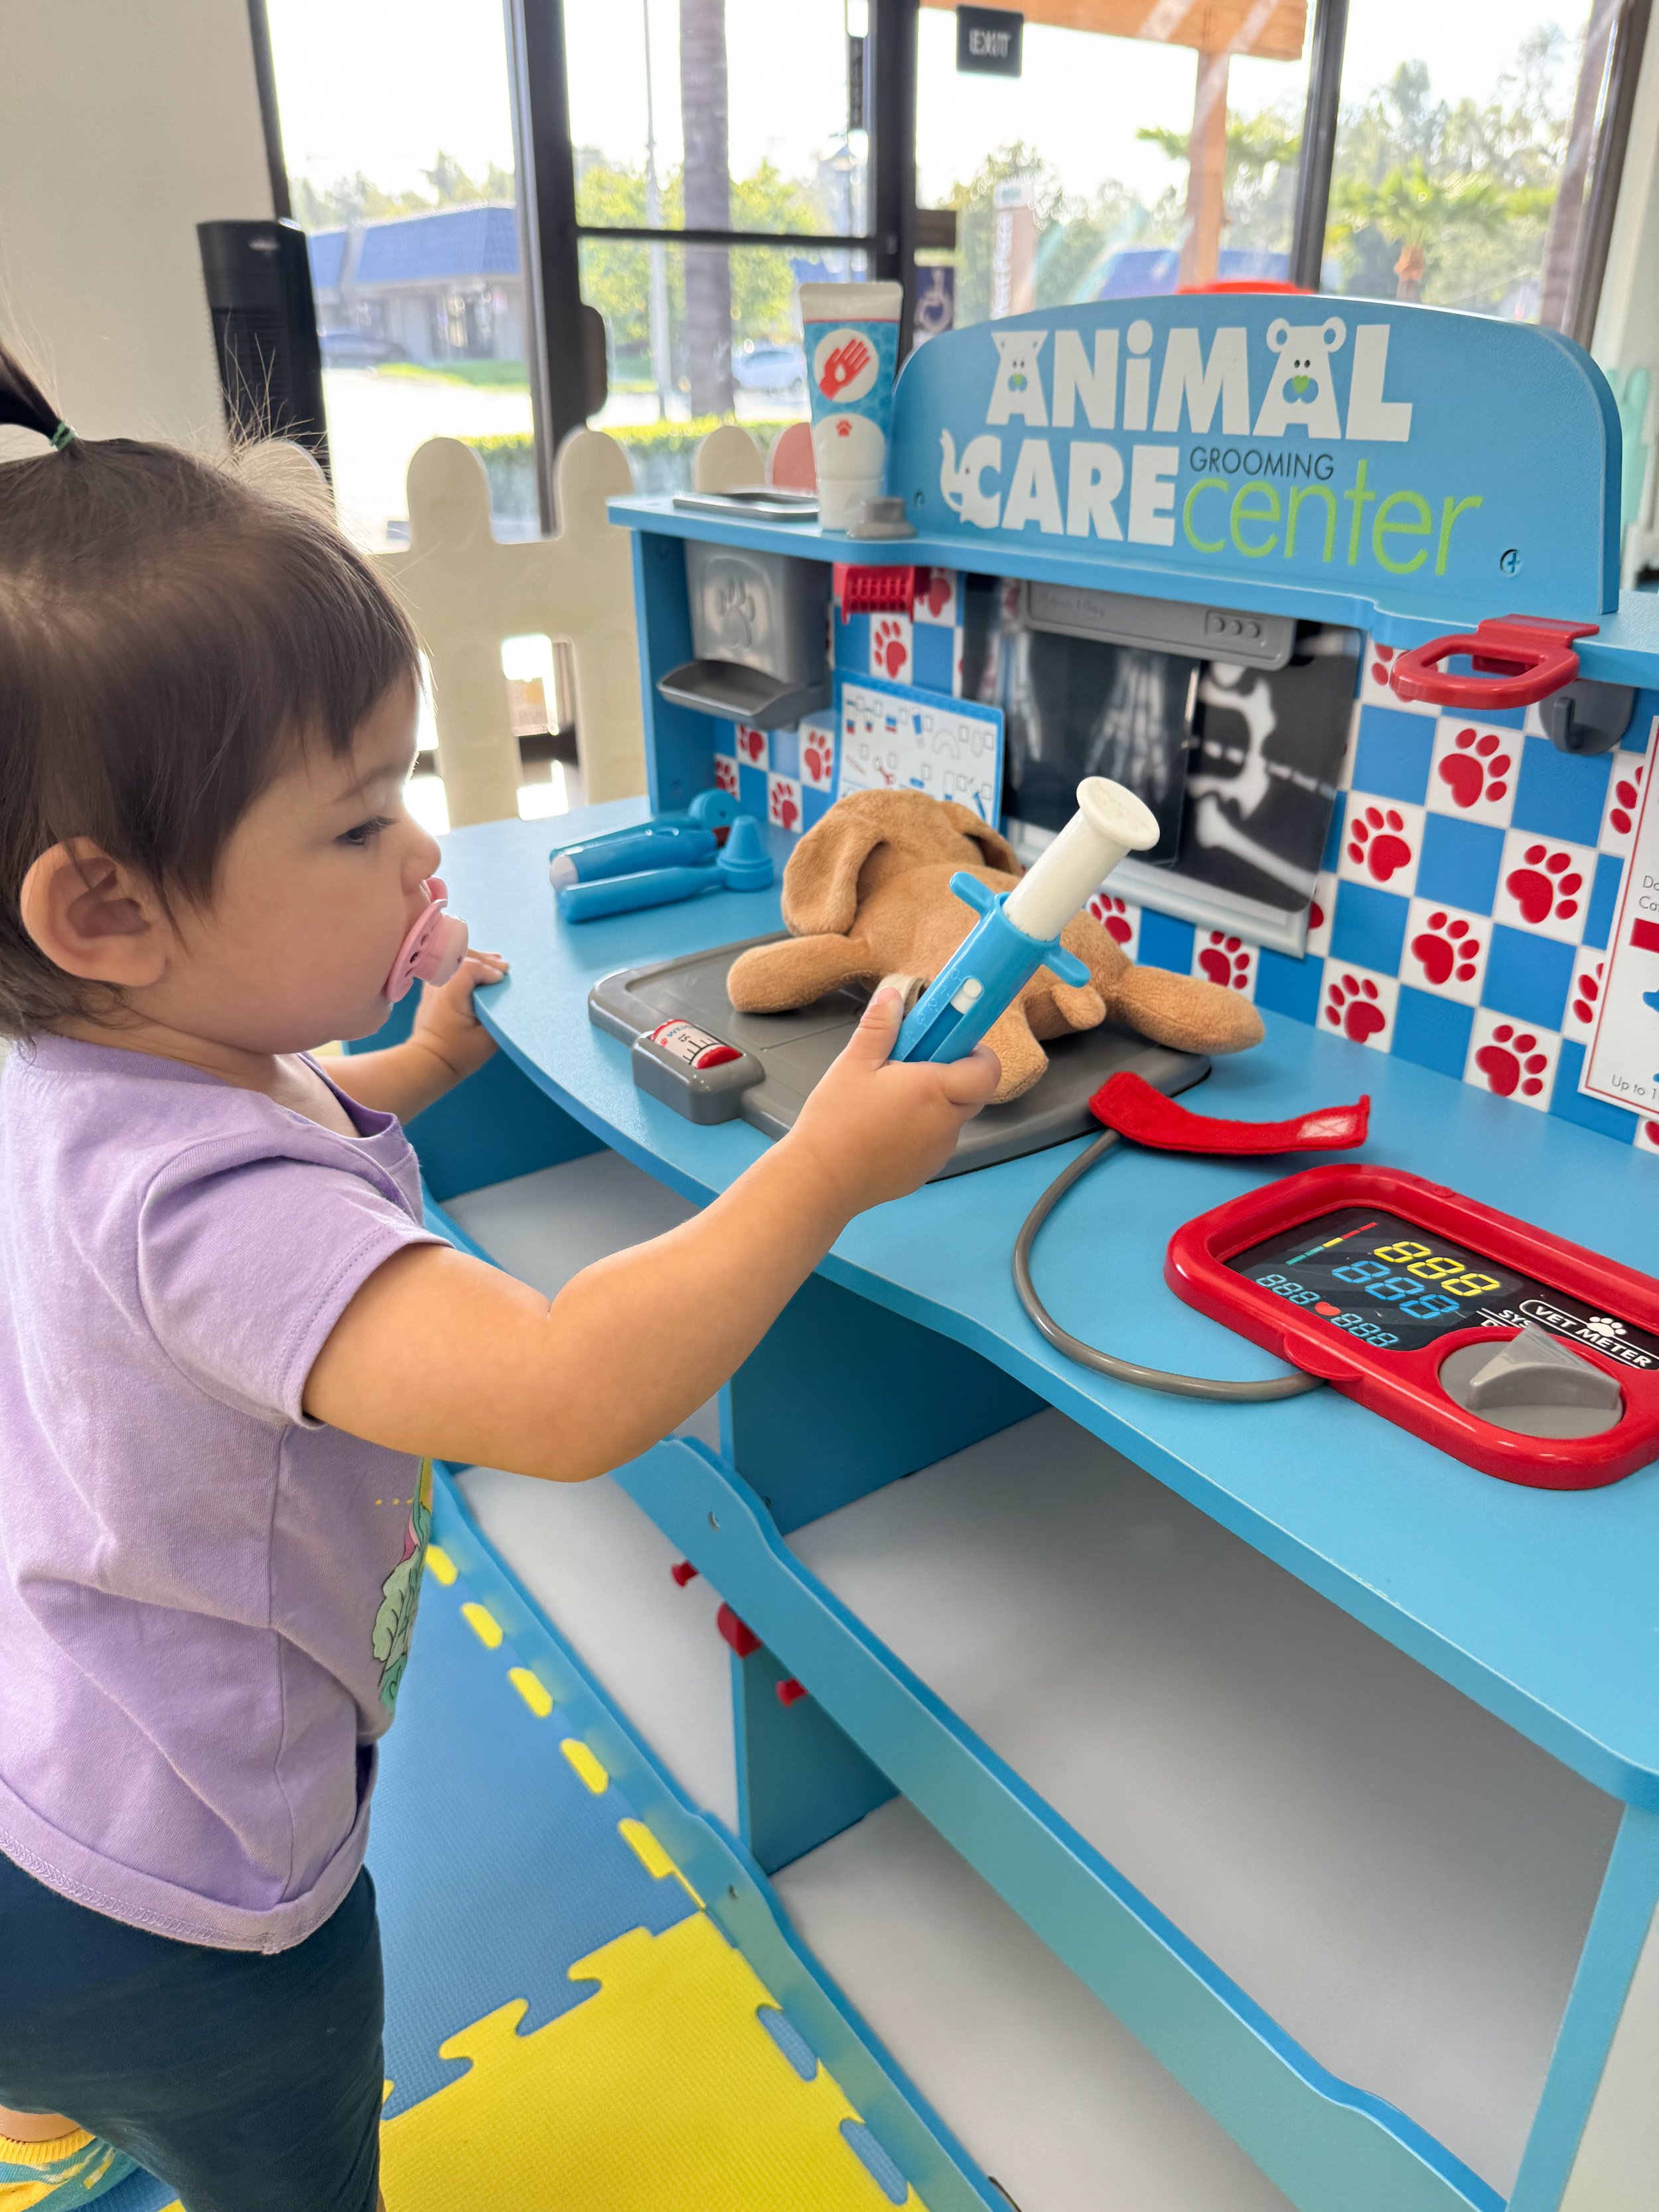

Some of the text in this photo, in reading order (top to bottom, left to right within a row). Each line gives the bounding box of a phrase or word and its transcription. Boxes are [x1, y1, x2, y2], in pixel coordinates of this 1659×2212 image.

[969, 29, 1012, 58] EXIT
[939, 428, 1334, 547] CARE GROOMING
[1183, 458, 1483, 577] center
[678, 1033, 691, 1043] 15
[1611, 1074, 1629, 1092] Up
[1633, 1083, 1645, 1095] to
[1256, 1274, 1321, 1305] 888
[1331, 1260, 1460, 1320] 888
[1373, 1240, 1501, 1297] 888
[1330, 1313, 1400, 1348] 888
[1534, 1305, 1652, 1368] VET METER
